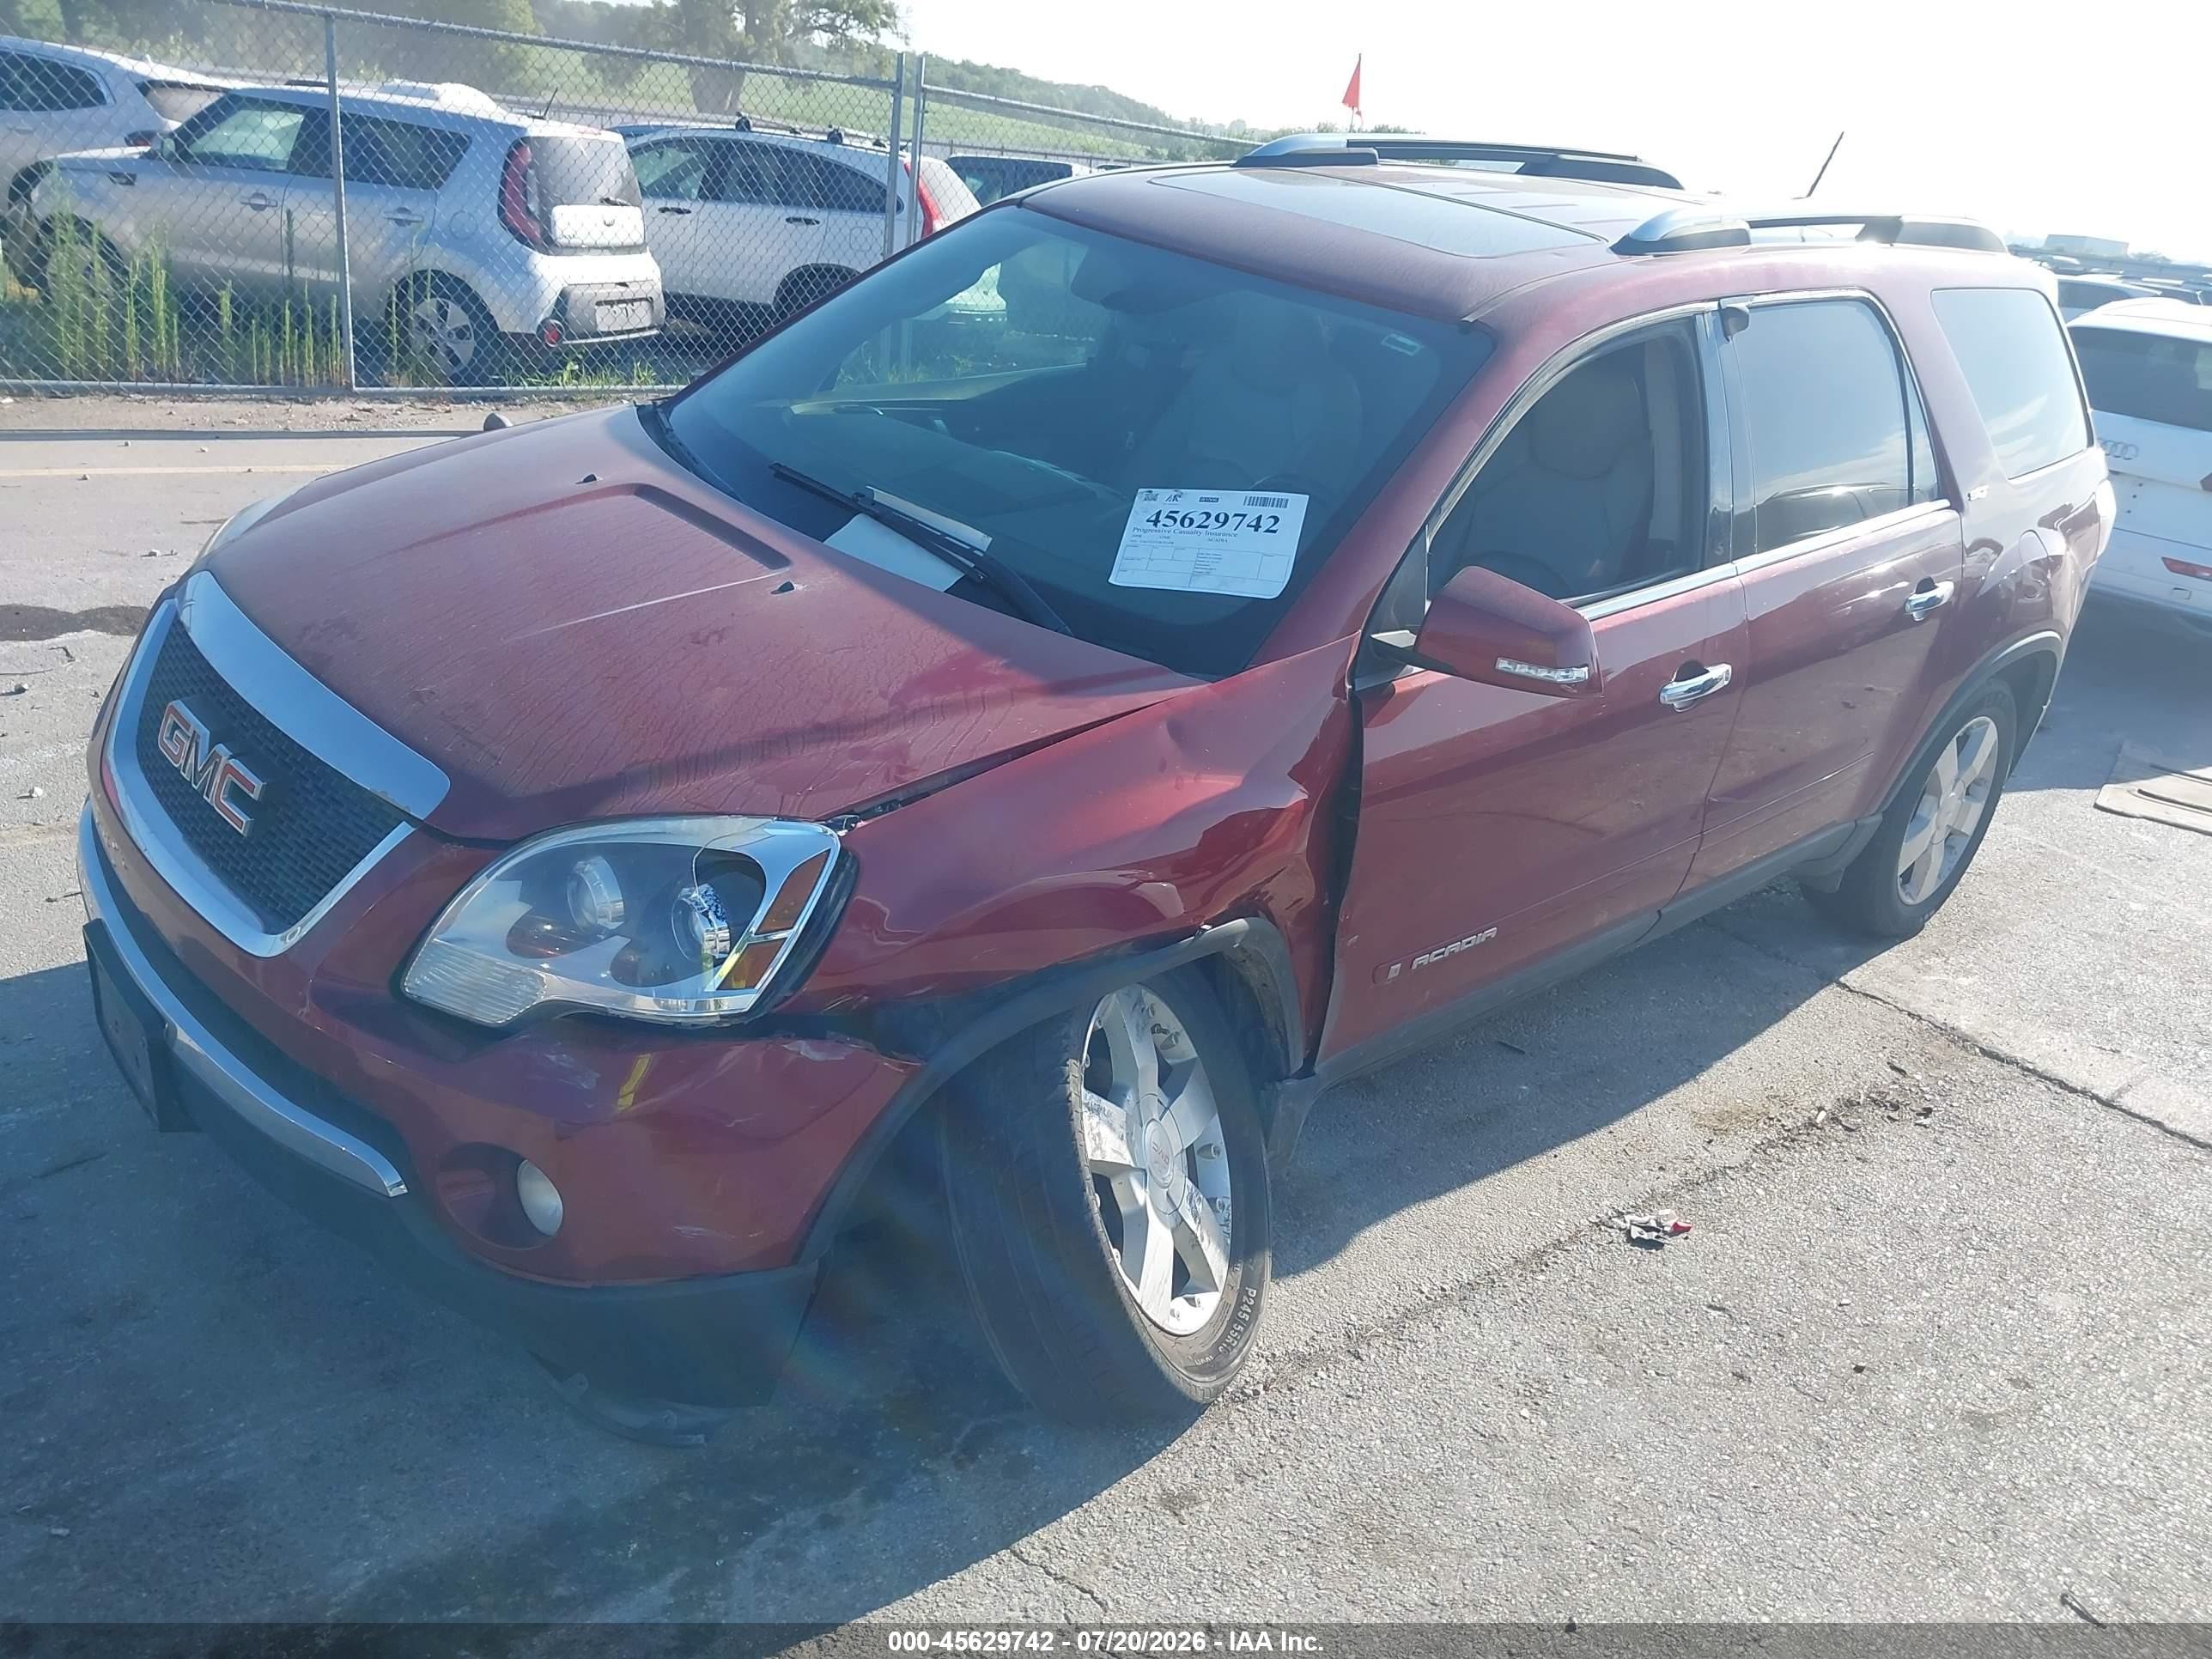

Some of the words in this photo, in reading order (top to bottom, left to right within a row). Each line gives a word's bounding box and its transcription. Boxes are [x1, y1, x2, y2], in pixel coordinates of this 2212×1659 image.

[1133, 526, 1173, 535] Progressive
[1173, 528, 1203, 538] Casualty
[1205, 530, 1238, 538] Insurance
[1146, 508, 1280, 534] 45629742
[158, 701, 266, 836] GMC
[1411, 927, 1498, 969] ACADIA
